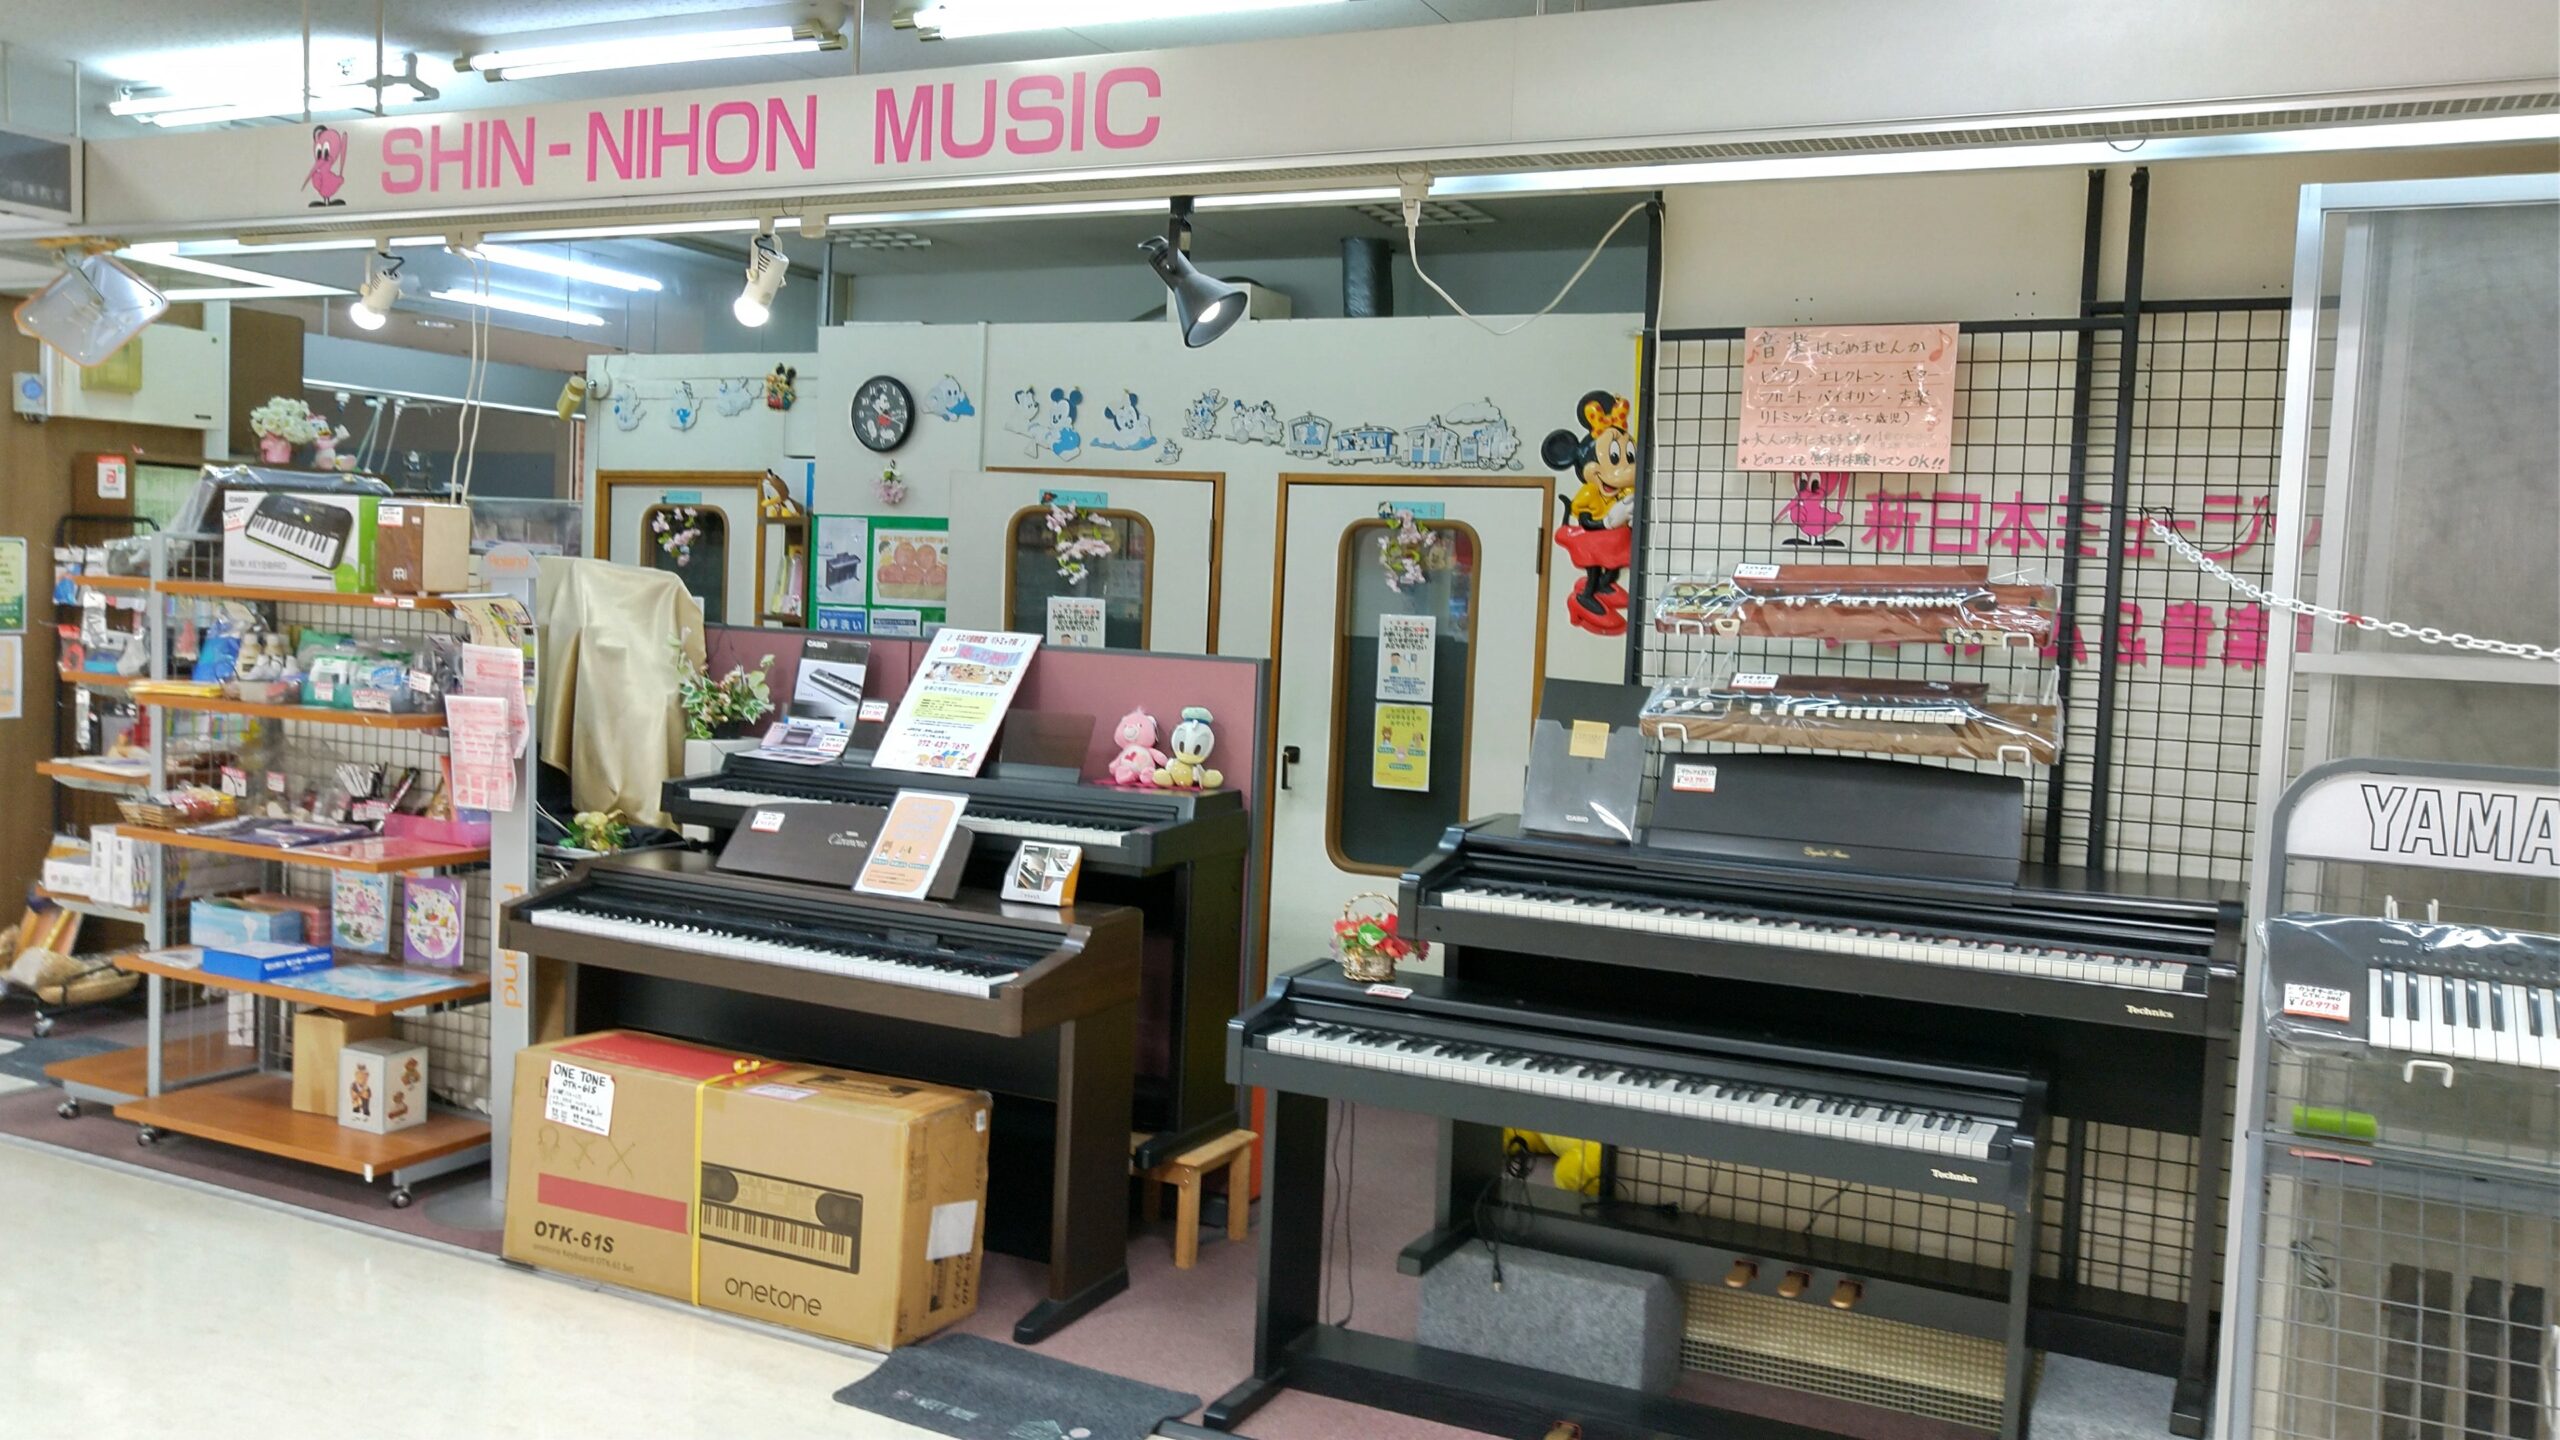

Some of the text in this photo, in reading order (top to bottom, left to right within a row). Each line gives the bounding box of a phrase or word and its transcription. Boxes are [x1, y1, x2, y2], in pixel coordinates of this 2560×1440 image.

[874, 66, 1163, 165] MUSIC
[806, 640, 828, 649] CASIO
[1565, 814, 1589, 823] CASIO
[2125, 1004, 2174, 1019] Technics
[553, 1063, 606, 1087] ONE TONE
[562, 1079, 597, 1095] OTK-61S
[1930, 1168, 1978, 1184] Technics
[534, 1220, 616, 1254] OTK-61S
[724, 1277, 822, 1317] onetone
